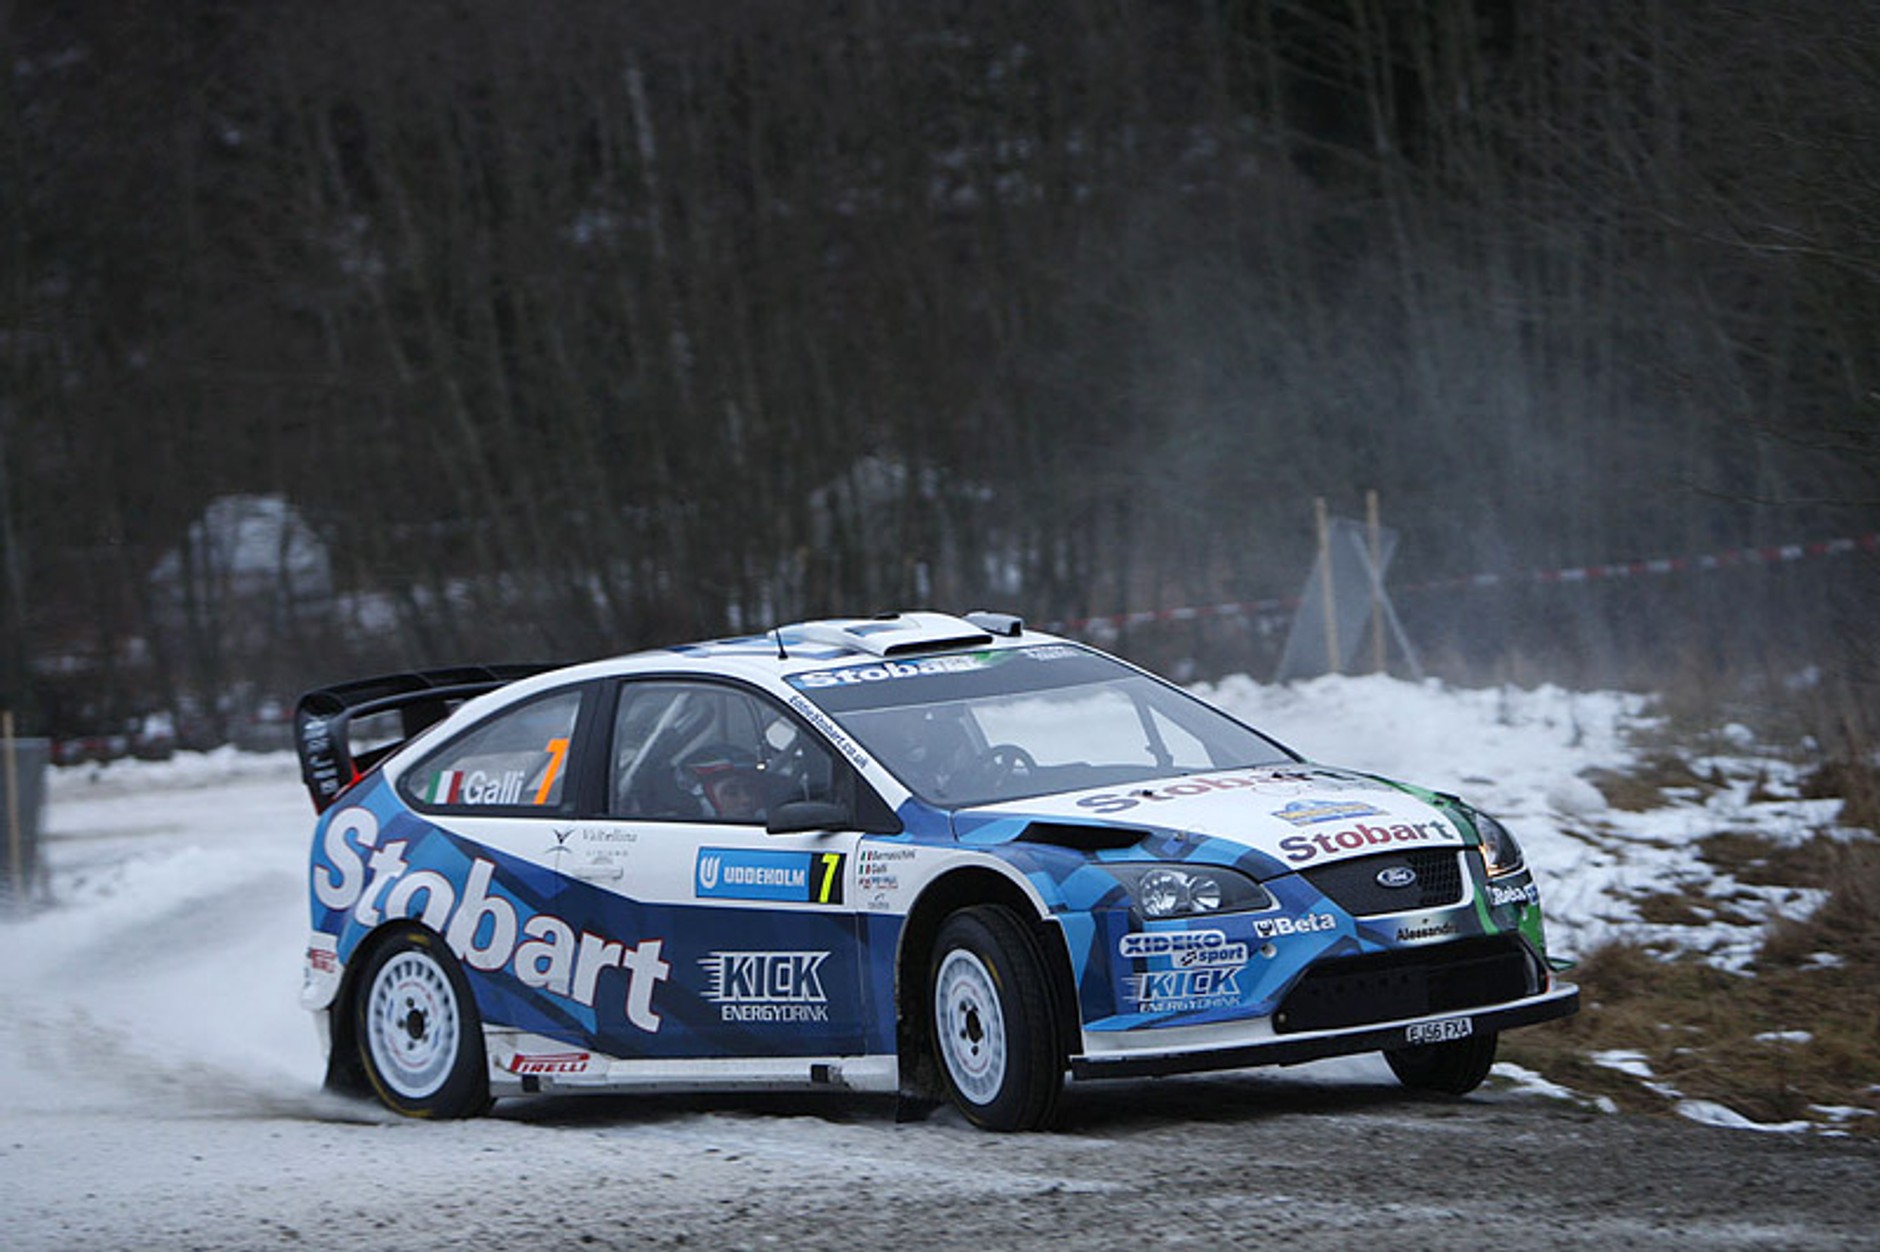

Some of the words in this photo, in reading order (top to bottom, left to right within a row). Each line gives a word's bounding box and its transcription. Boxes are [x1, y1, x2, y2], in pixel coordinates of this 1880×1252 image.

[799, 652, 988, 688] Stobart
[463, 770, 526, 805] Galli
[1278, 821, 1454, 863] Stobart
[818, 852, 841, 904] 7
[309, 805, 670, 1033] Stobart
[1274, 912, 1336, 936] Beta
[1198, 946, 1243, 964] sport
[719, 951, 831, 1002] KICK
[510, 1052, 591, 1073] PIRELLI
